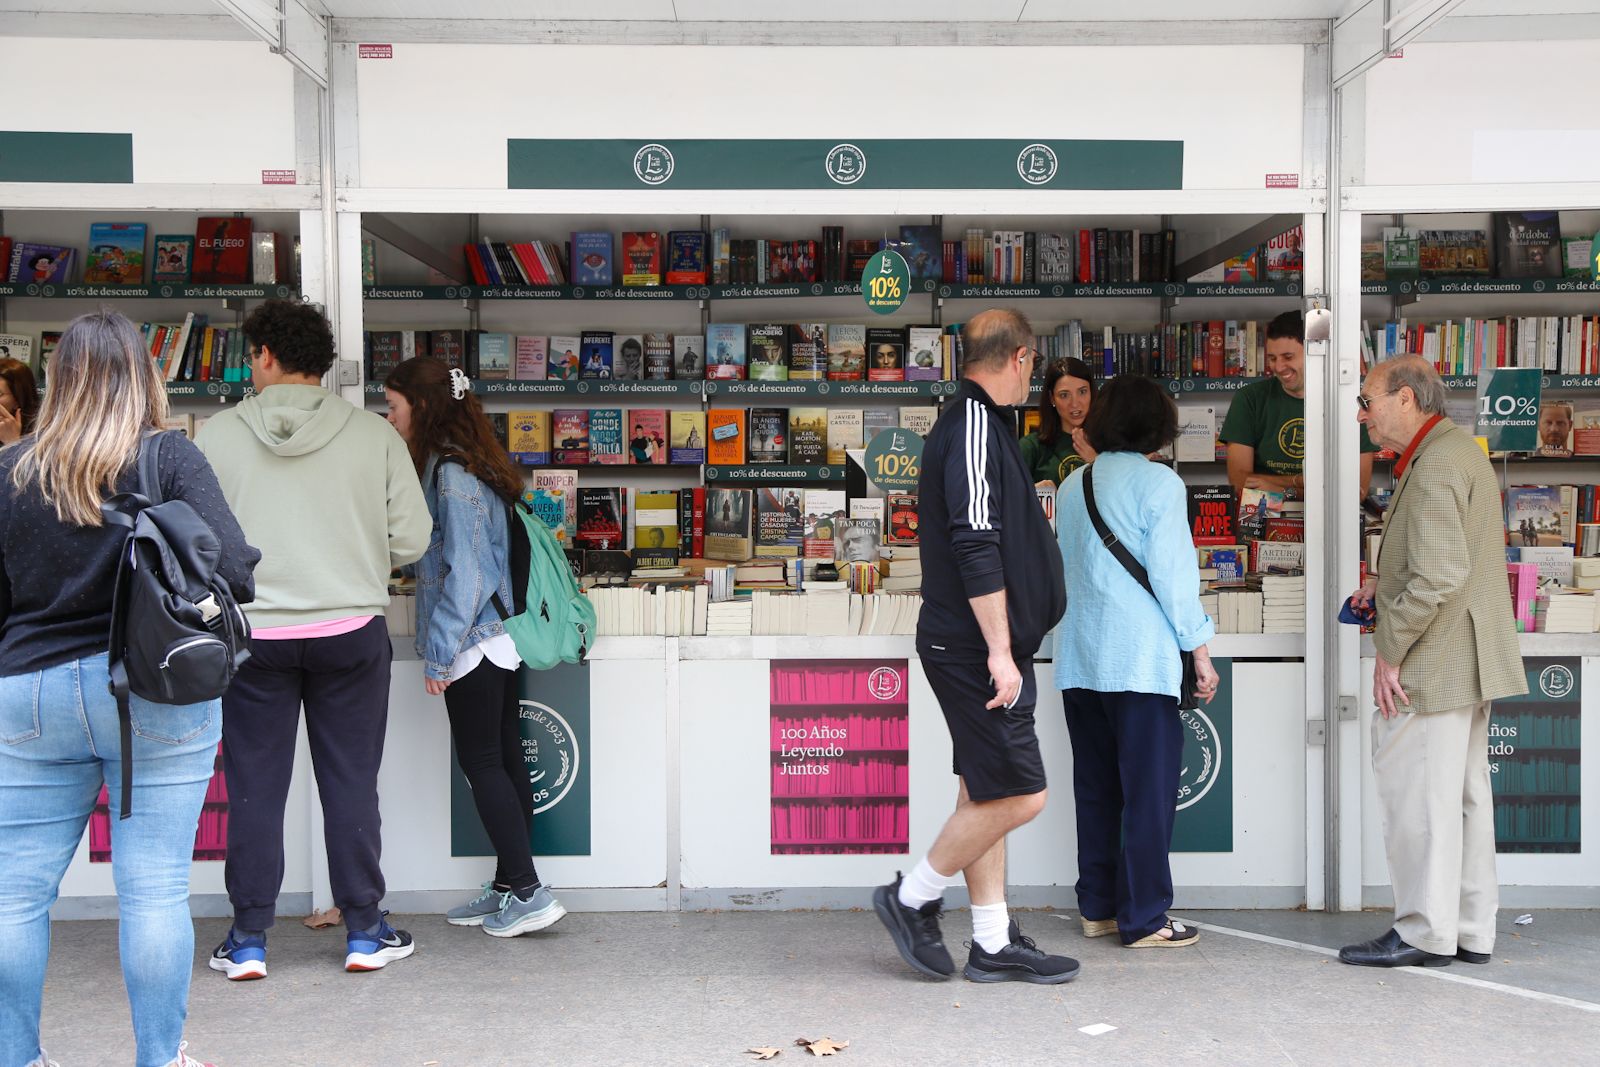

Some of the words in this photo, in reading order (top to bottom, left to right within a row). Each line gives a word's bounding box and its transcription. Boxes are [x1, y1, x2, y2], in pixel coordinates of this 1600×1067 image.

[213, 238, 244, 247] FUEGO
[9, 244, 24, 283] mafalda
[1041, 264, 1069, 273] LEIGH
[834, 285, 852, 293] 10%
[869, 277, 900, 298] 10%
[1197, 286, 1214, 294] 10%
[1216, 286, 1227, 294] de
[1228, 286, 1275, 294] descuento
[1441, 283, 1459, 291] 10%
[1461, 283, 1472, 291] de
[1473, 283, 1520, 291] descuento
[1556, 282, 1575, 290] 10%
[1576, 281, 1588, 290] de
[67, 287, 86, 296] 10%
[87, 287, 98, 296] de
[100, 287, 148, 296] descuento
[184, 288, 203, 296] 10%
[204, 288, 215, 296] de
[217, 288, 264, 296] descuento
[369, 288, 423, 297] descuento
[483, 289, 500, 297] 10%
[501, 289, 513, 297] de
[515, 289, 561, 297] descuento
[596, 289, 614, 298] 10%
[615, 289, 626, 298] de
[627, 289, 674, 298] descuento
[722, 287, 740, 296] 10%
[742, 287, 752, 296] de
[752, 287, 800, 296] descuento
[962, 287, 980, 296] 10%
[982, 287, 993, 296] de
[994, 287, 1040, 296] descuento
[1075, 287, 1092, 296] 10%
[1094, 287, 1105, 296] de
[1106, 287, 1152, 296] descuento
[1446, 379, 1464, 387] 10%
[1465, 379, 1476, 387] de
[1562, 379, 1580, 387] 10%
[1581, 378, 1591, 387] de
[600, 383, 618, 392] 10%
[619, 383, 630, 392] de
[631, 383, 678, 392] descuento
[729, 384, 746, 393] 10%
[747, 384, 758, 393] de
[760, 384, 806, 393] descuento
[841, 385, 858, 393] 10%
[860, 385, 870, 393] de
[872, 385, 918, 393] descuento
[1480, 396, 1537, 416] 10%
[592, 419, 619, 431] DONDE
[592, 443, 620, 454] BRILLA
[874, 454, 918, 477] 10%
[729, 470, 747, 478] 10%
[748, 470, 759, 478] de
[761, 470, 806, 478] descuento
[536, 476, 574, 487] ROMPER
[557, 503, 562, 512] A
[1200, 502, 1227, 516] TODO
[1194, 516, 1232, 535] ARDE
[546, 720, 566, 745] 1923
[780, 728, 808, 739] 100
[809, 725, 846, 739] Años
[1188, 717, 1208, 741] 1923
[1488, 724, 1517, 737] ños
[520, 738, 538, 746] asa
[780, 744, 844, 761] Leyendo
[780, 763, 830, 775] Juntos
